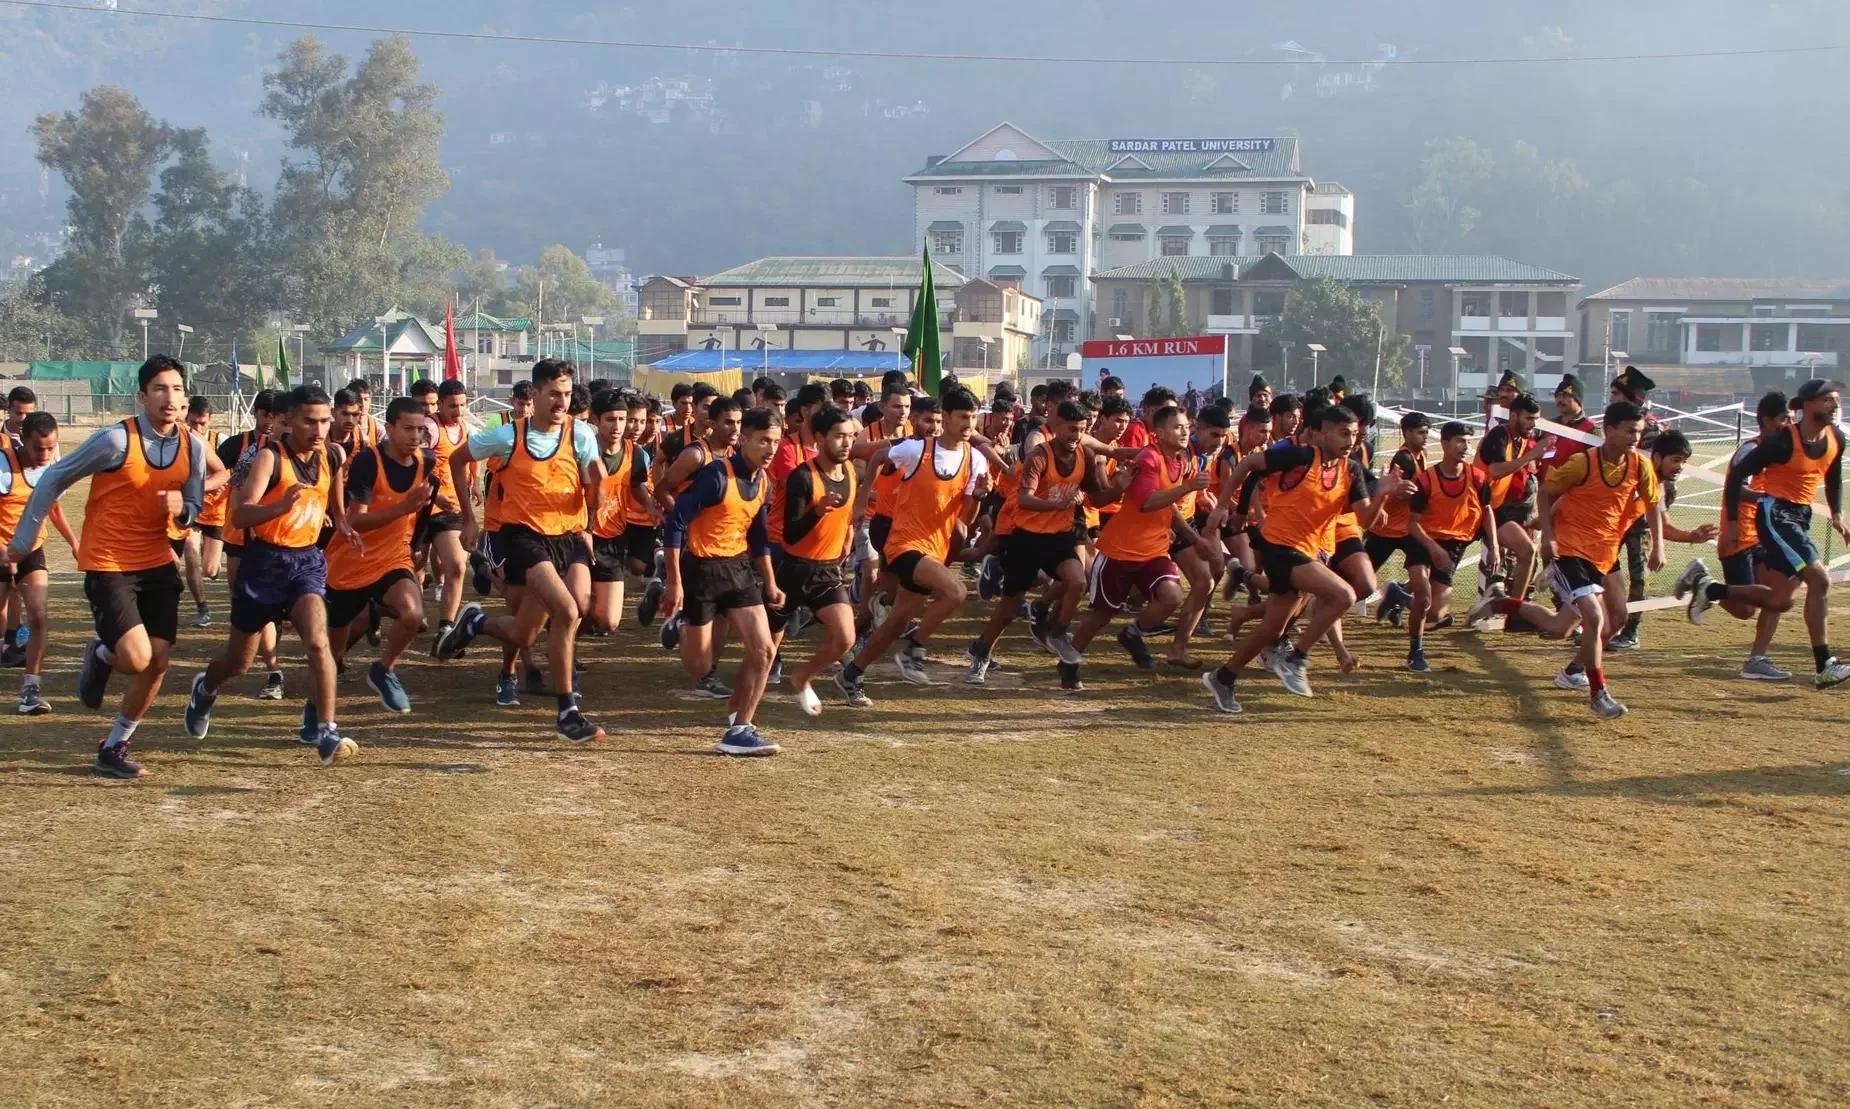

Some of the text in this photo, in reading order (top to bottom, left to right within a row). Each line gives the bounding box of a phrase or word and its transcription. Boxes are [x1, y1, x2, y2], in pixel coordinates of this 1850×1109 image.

[1111, 140, 1271, 151] SARDAR PATEL UNIVERSITY
[1108, 341, 1199, 356] 1.6 KM RUN
